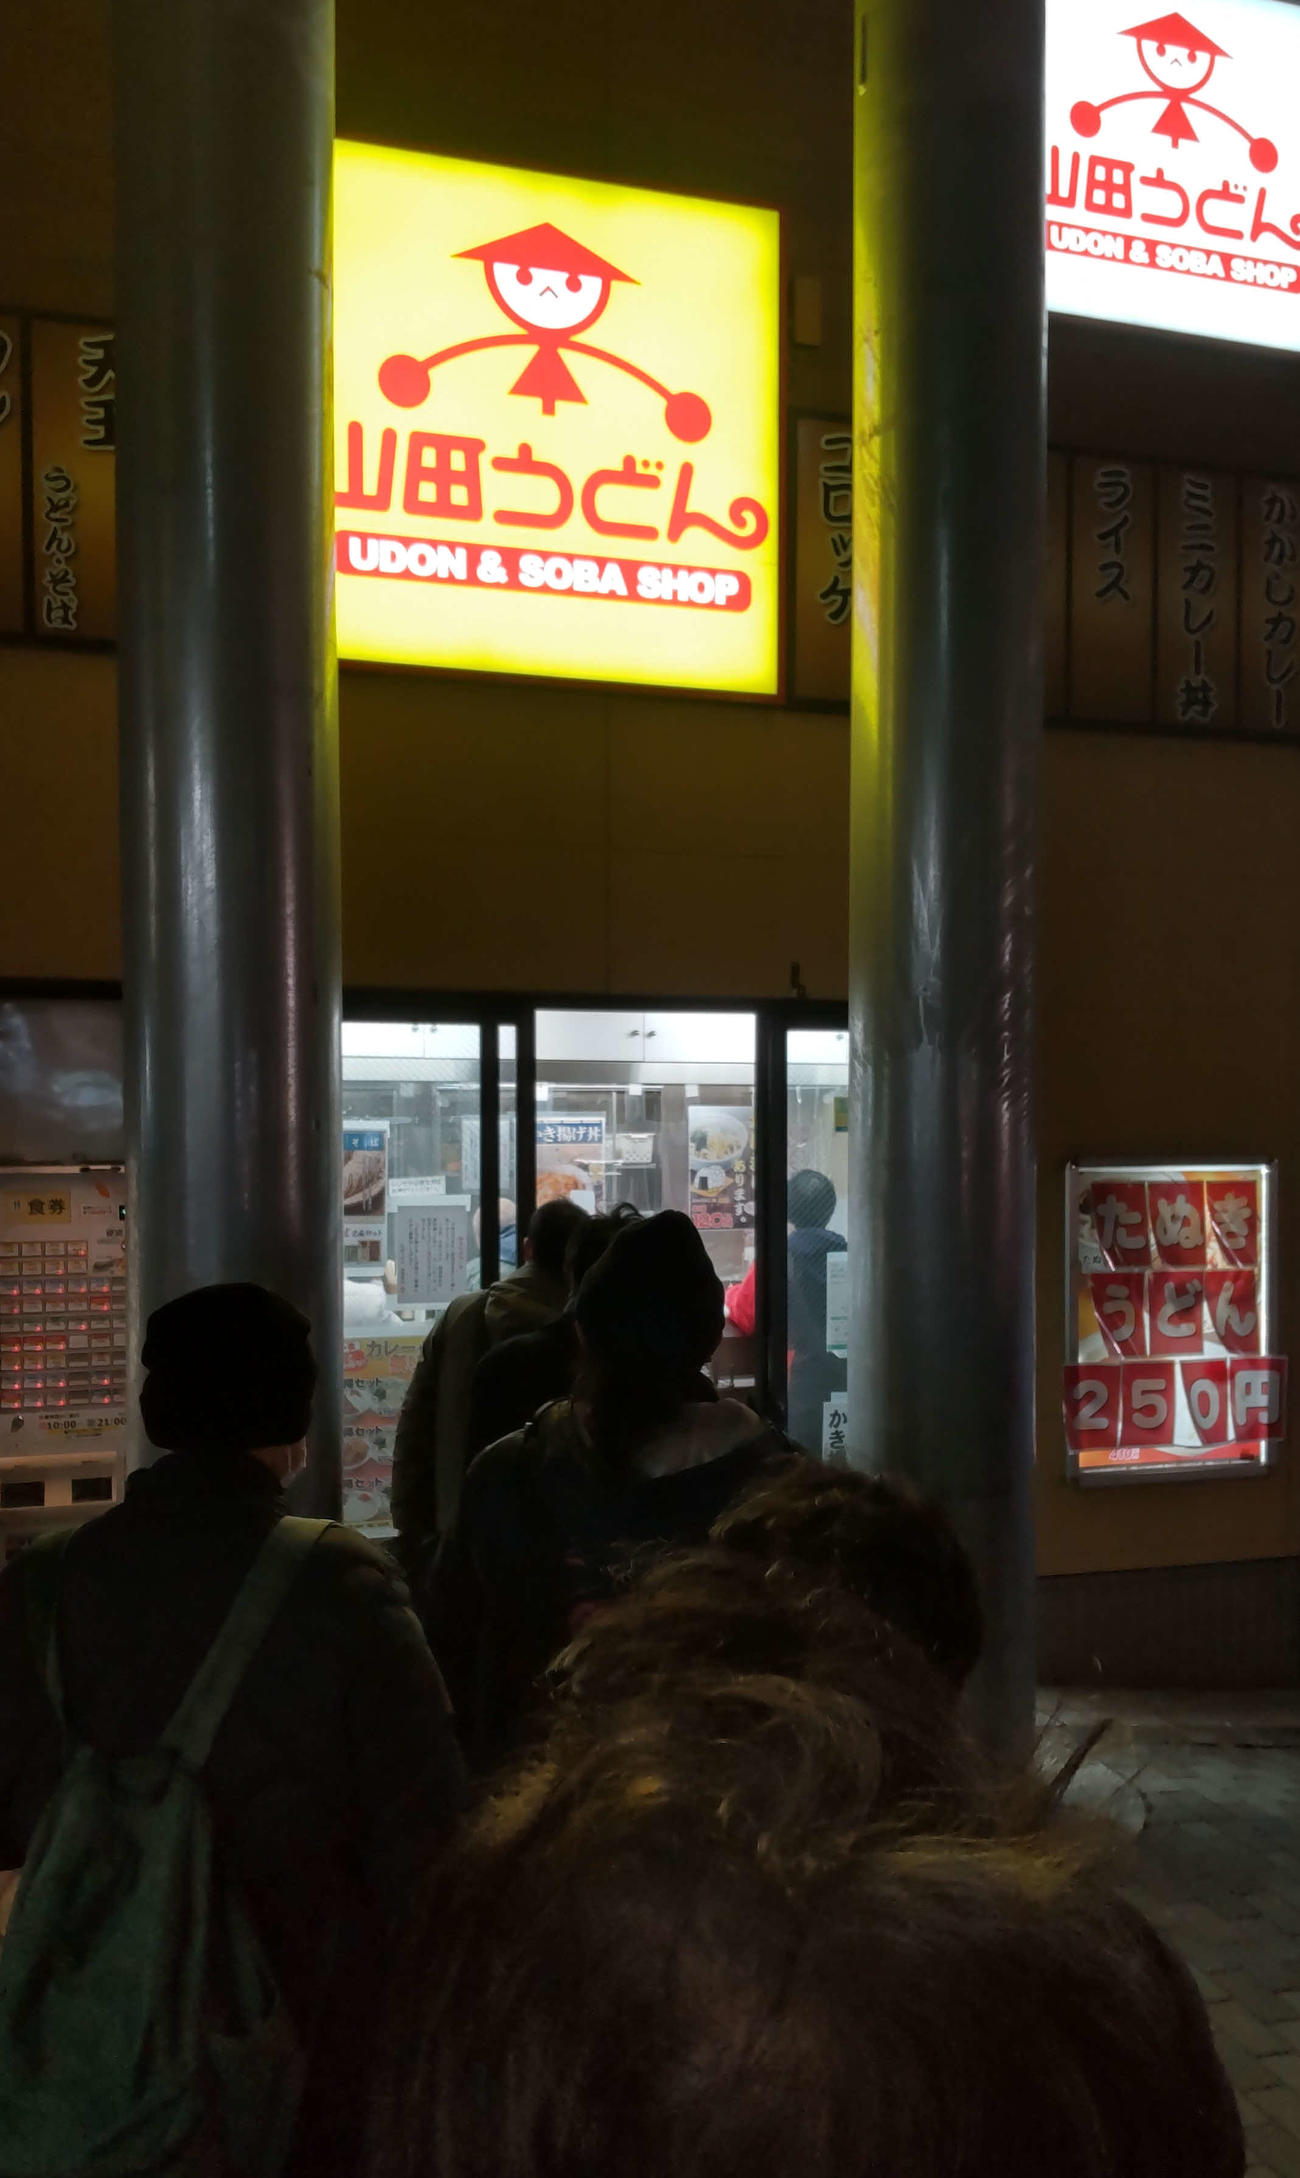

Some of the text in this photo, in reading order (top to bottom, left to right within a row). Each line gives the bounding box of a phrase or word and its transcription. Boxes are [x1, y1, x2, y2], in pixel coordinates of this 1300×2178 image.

[1050, 224, 1298, 289] UDON & SOBA SHOP
[1094, 468, 1132, 605] ライス
[348, 537, 740, 606] UDON & SOBA SHOP
[1097, 1192, 1251, 1250] たぬき
[1102, 1280, 1257, 1342] うどん
[1072, 1369, 1280, 1430] 250円
